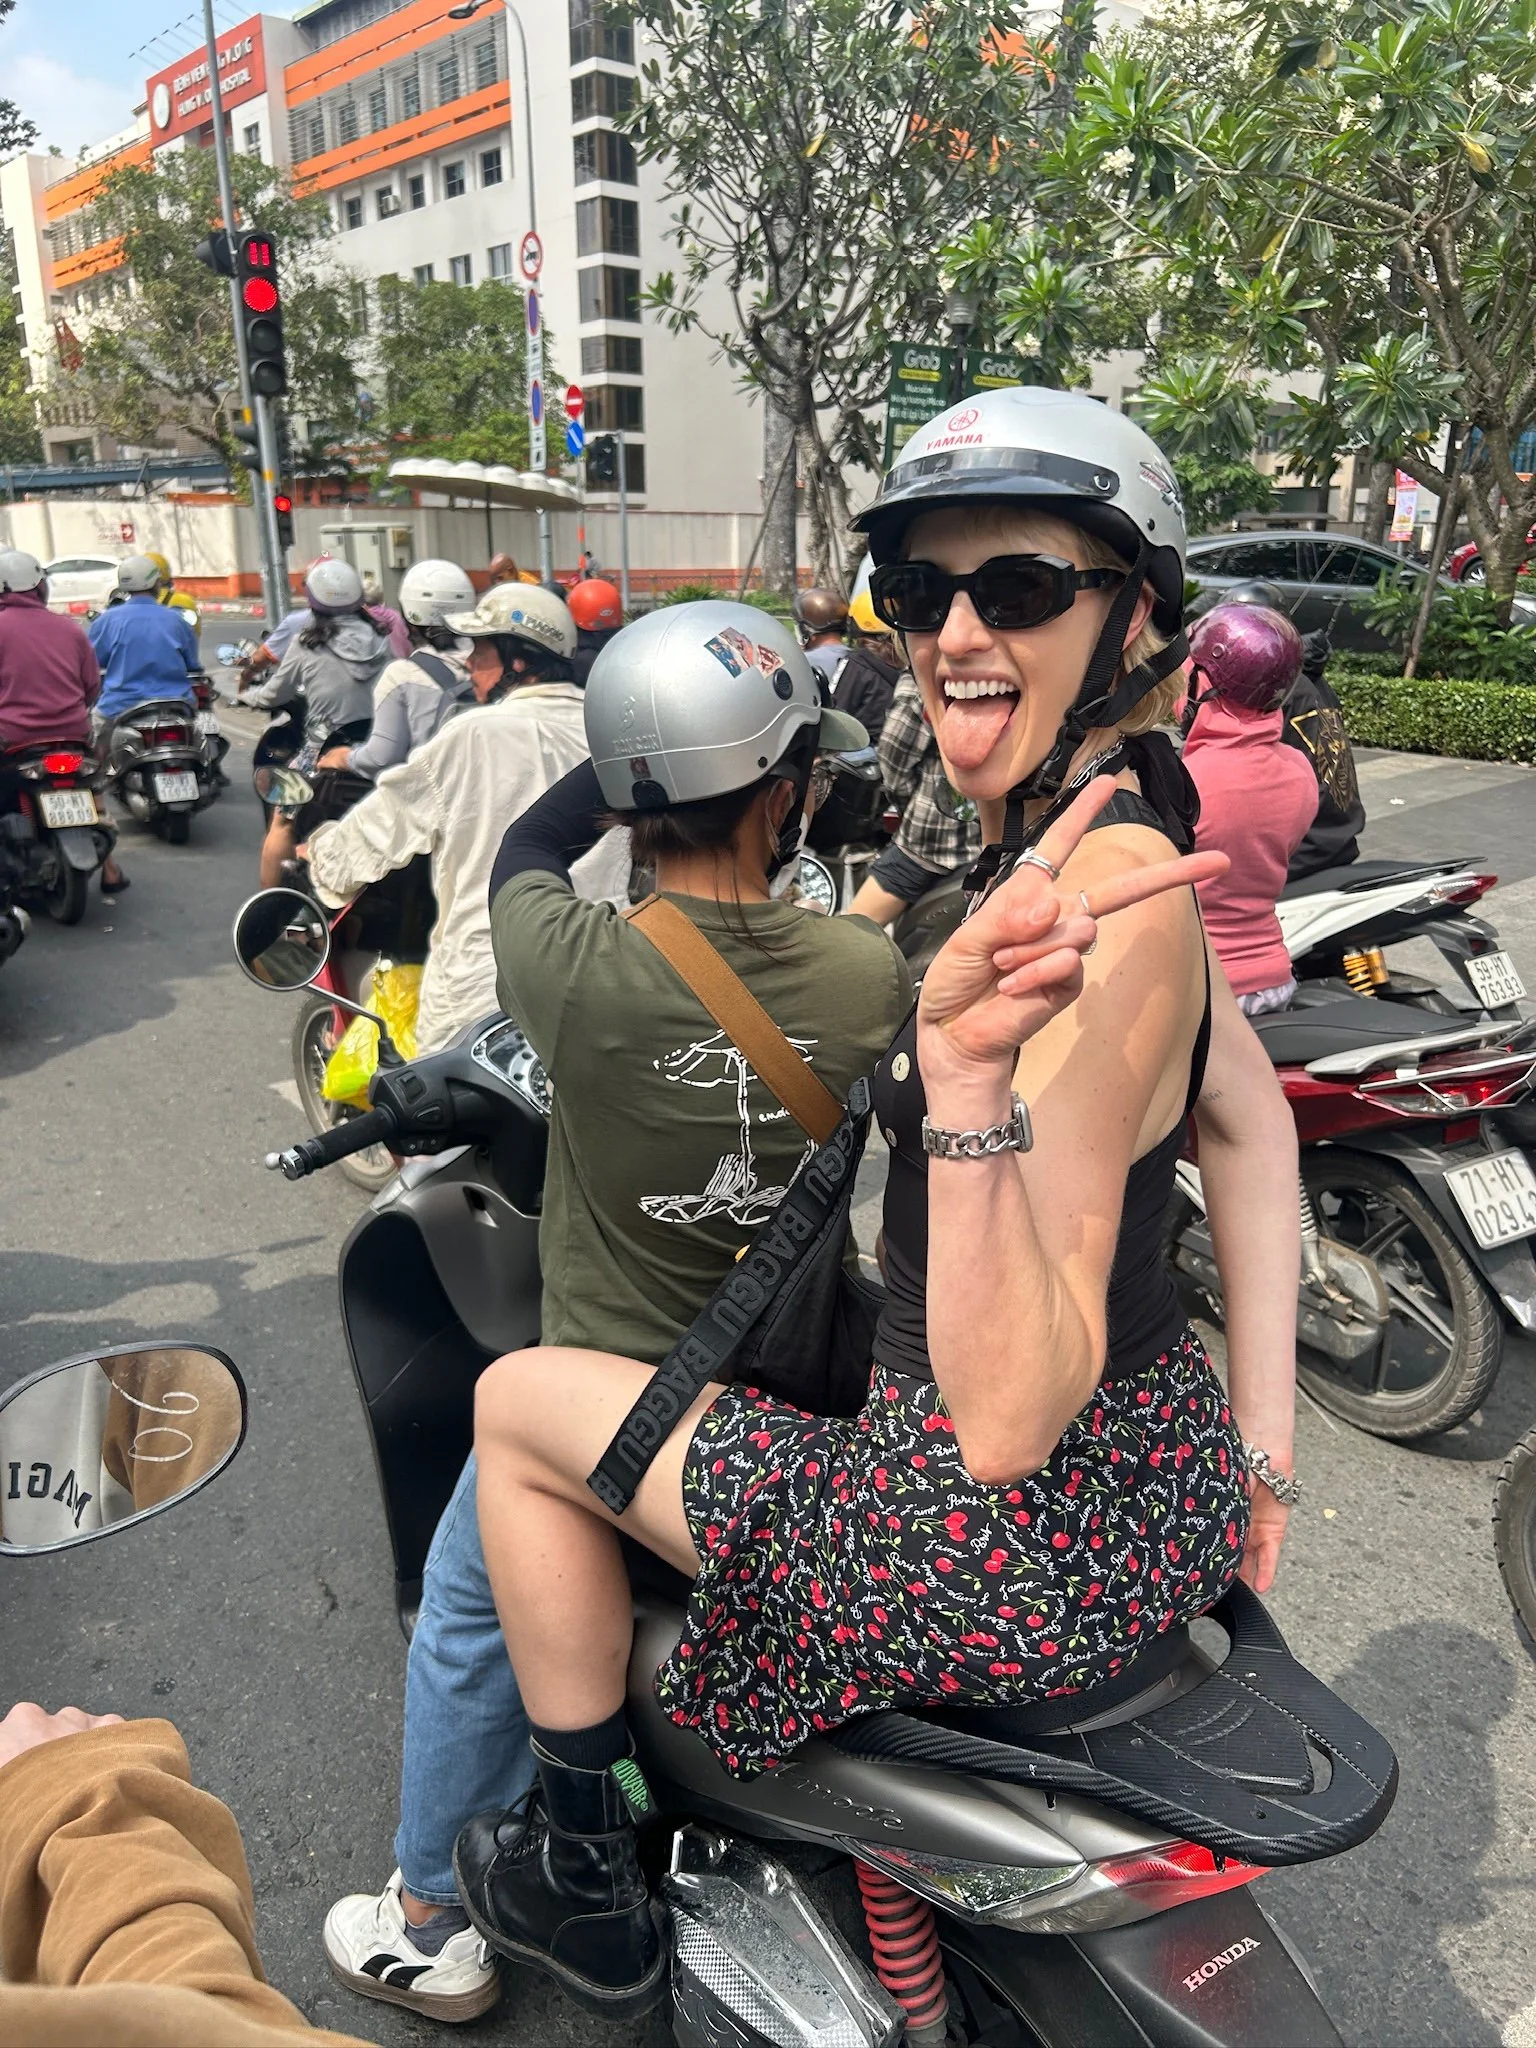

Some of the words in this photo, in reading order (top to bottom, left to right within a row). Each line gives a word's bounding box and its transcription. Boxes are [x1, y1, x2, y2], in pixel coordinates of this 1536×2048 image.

[903, 348, 941, 371] Grab
[979, 357, 1021, 379] Grab
[1474, 955, 1508, 981] 59-H1
[1480, 976, 1523, 1008] 763.93
[804, 1120, 855, 1206] GGU
[1459, 1156, 1524, 1204] 71-H1
[711, 1202, 815, 1338] BAGGU
[617, 1334, 719, 1472] BAGGU
[925, 1443, 960, 1457] Paris
[945, 1493, 985, 1510] Paris
[1023, 1478, 1049, 1507] Paris
[970, 1522, 993, 1555] Paris
[1030, 1550, 1059, 1580] Paris
[974, 1613, 1018, 1632] Paris
[1061, 1650, 1098, 1667] Paris
[1182, 1936, 1261, 1993] HONDA
